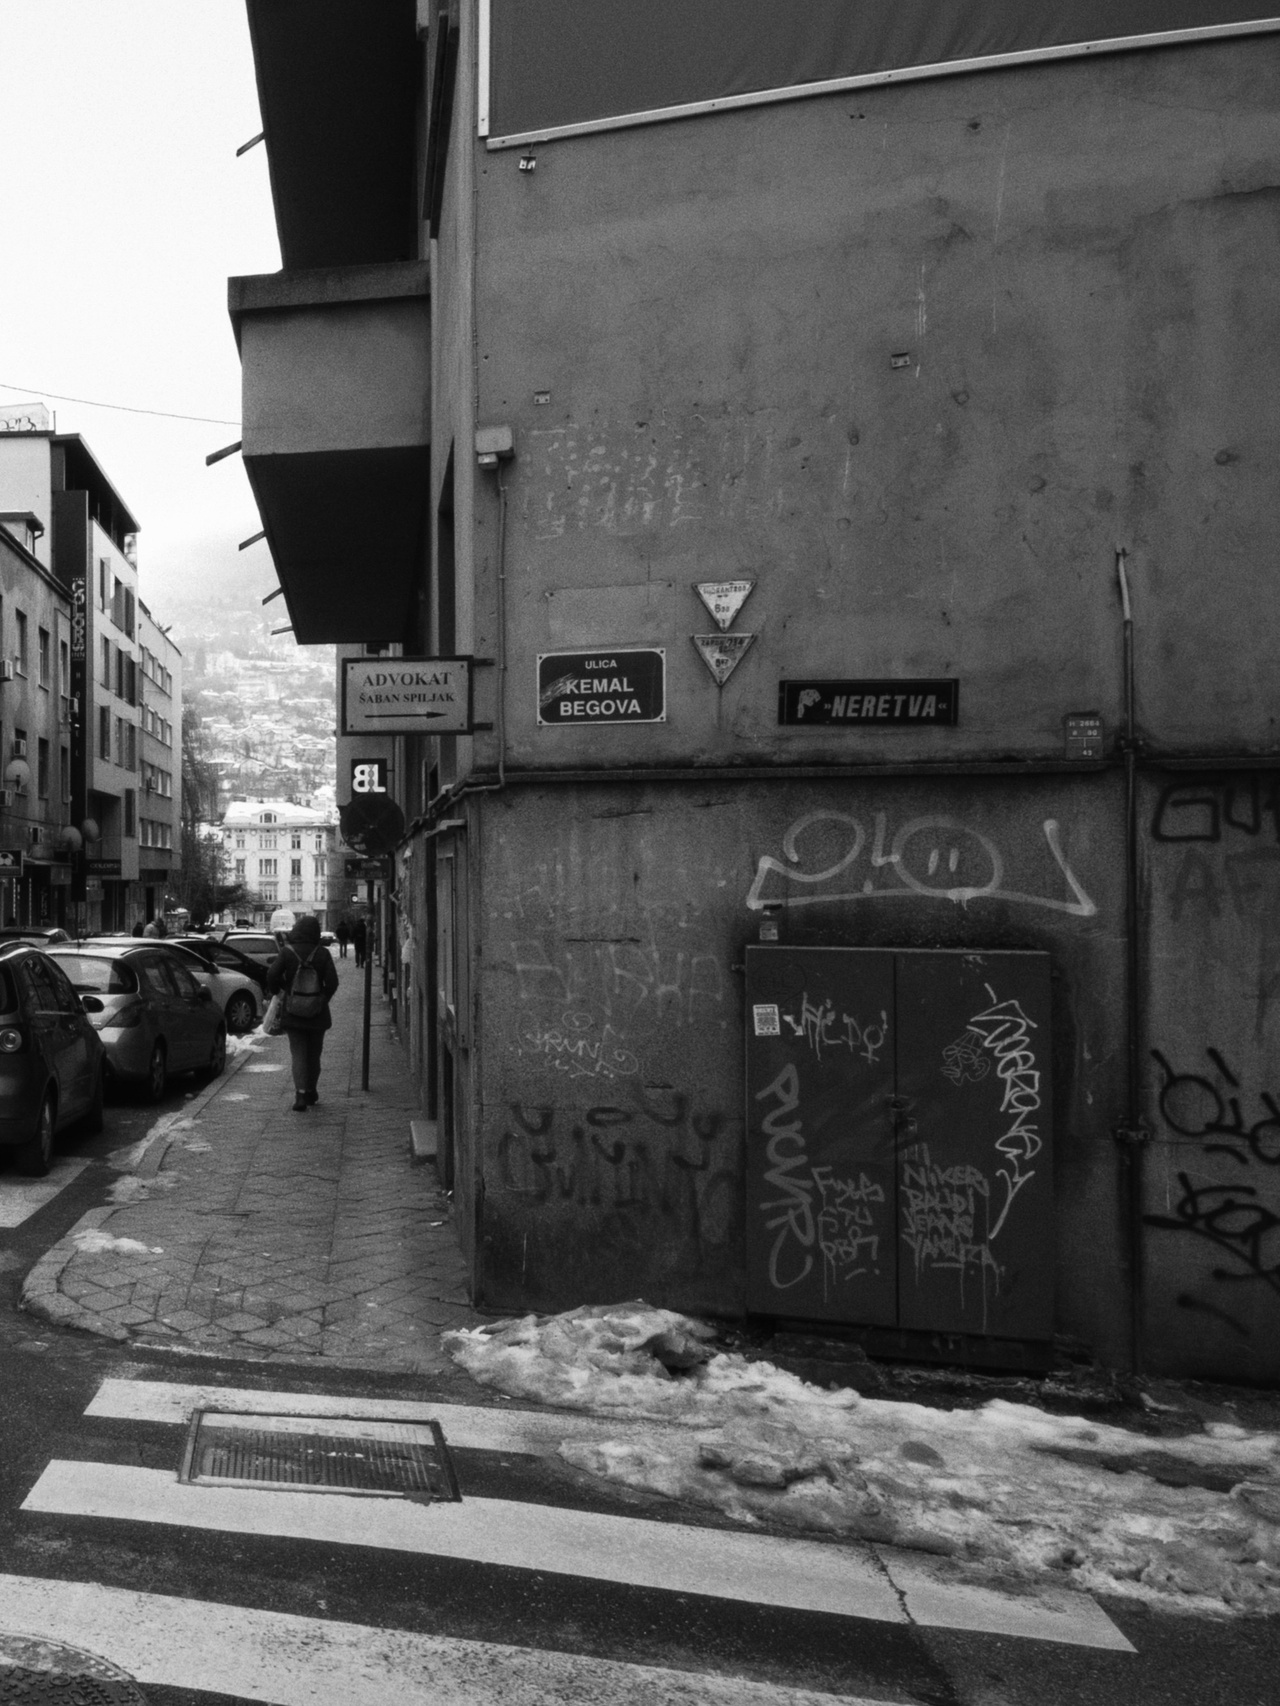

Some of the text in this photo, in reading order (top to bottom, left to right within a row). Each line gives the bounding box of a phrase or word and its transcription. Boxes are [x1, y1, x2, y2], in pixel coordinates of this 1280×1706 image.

[584, 659, 618, 670] ULICA
[363, 672, 452, 687] ADVOKAT
[566, 677, 635, 695] KEMAL
[358, 692, 455, 704] ŠABAN SPILJAK
[559, 698, 642, 717] BEGOVA
